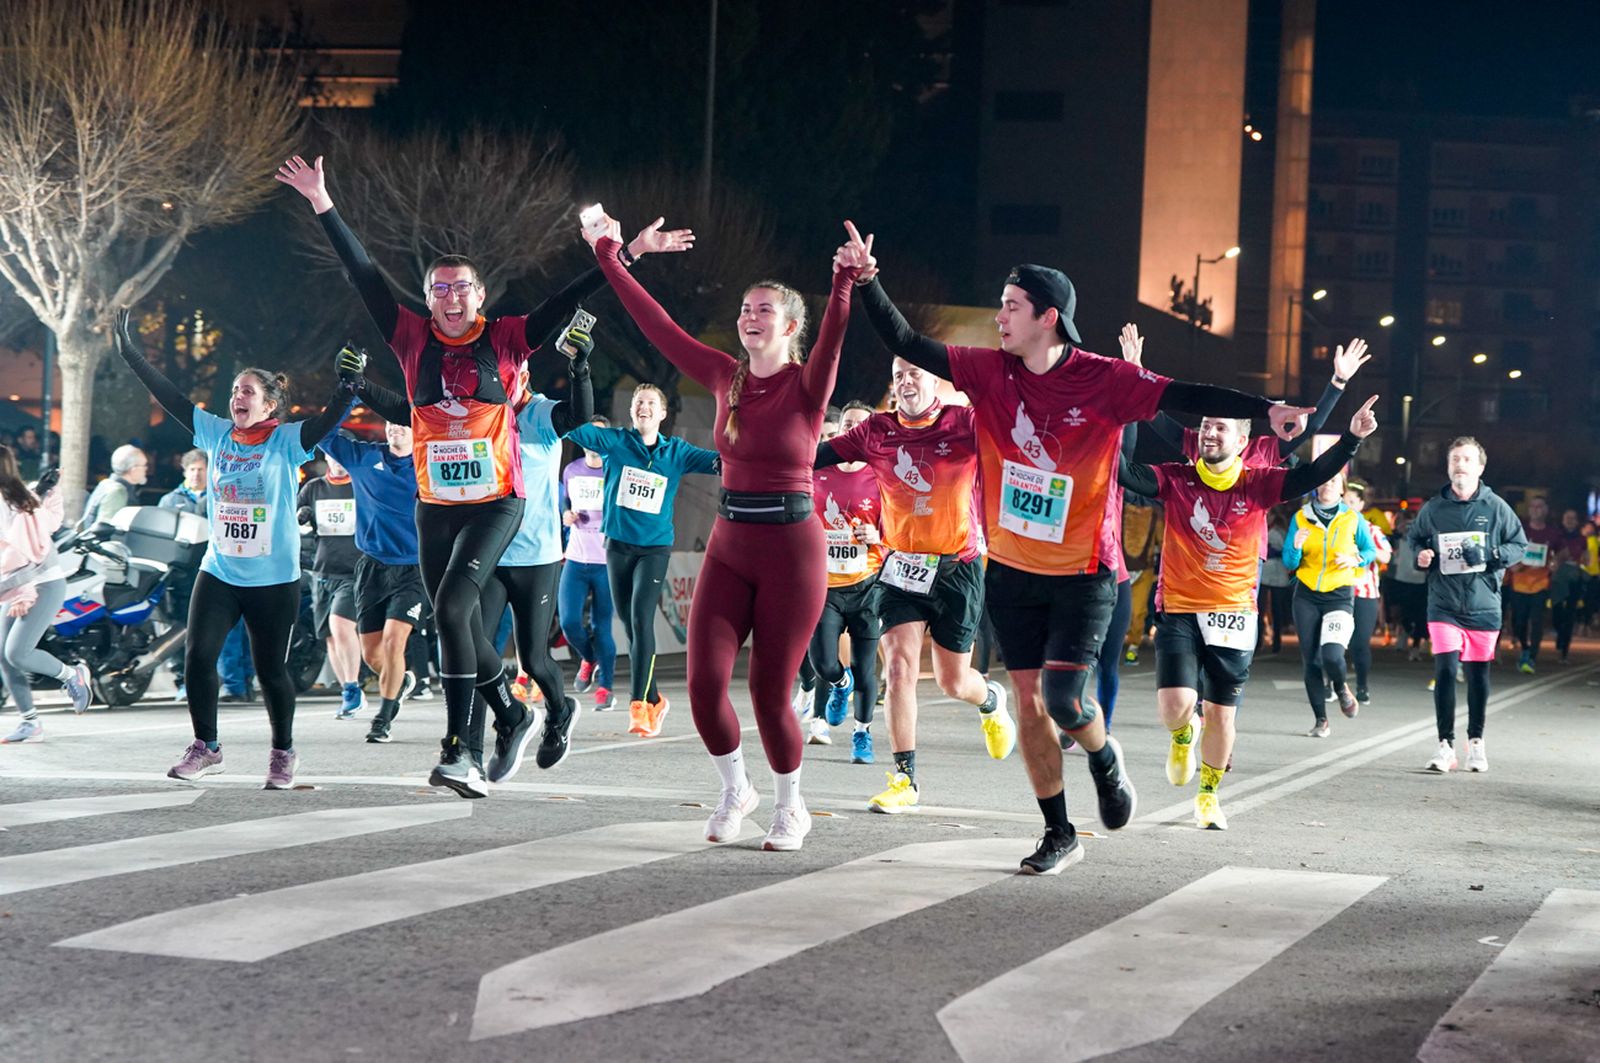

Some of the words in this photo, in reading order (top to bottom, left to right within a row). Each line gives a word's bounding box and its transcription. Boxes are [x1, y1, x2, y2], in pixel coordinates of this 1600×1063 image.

[1023, 440, 1041, 458] 43
[440, 460, 482, 481] 8270
[904, 470, 919, 485] 43
[629, 482, 656, 500] 5151
[1012, 488, 1054, 518] 8291
[224, 522, 258, 540] 7687
[832, 517, 844, 530] 43
[1200, 526, 1213, 541] 43
[828, 546, 858, 559] 4760
[893, 560, 929, 583] 3922
[1207, 612, 1245, 631] 3923
